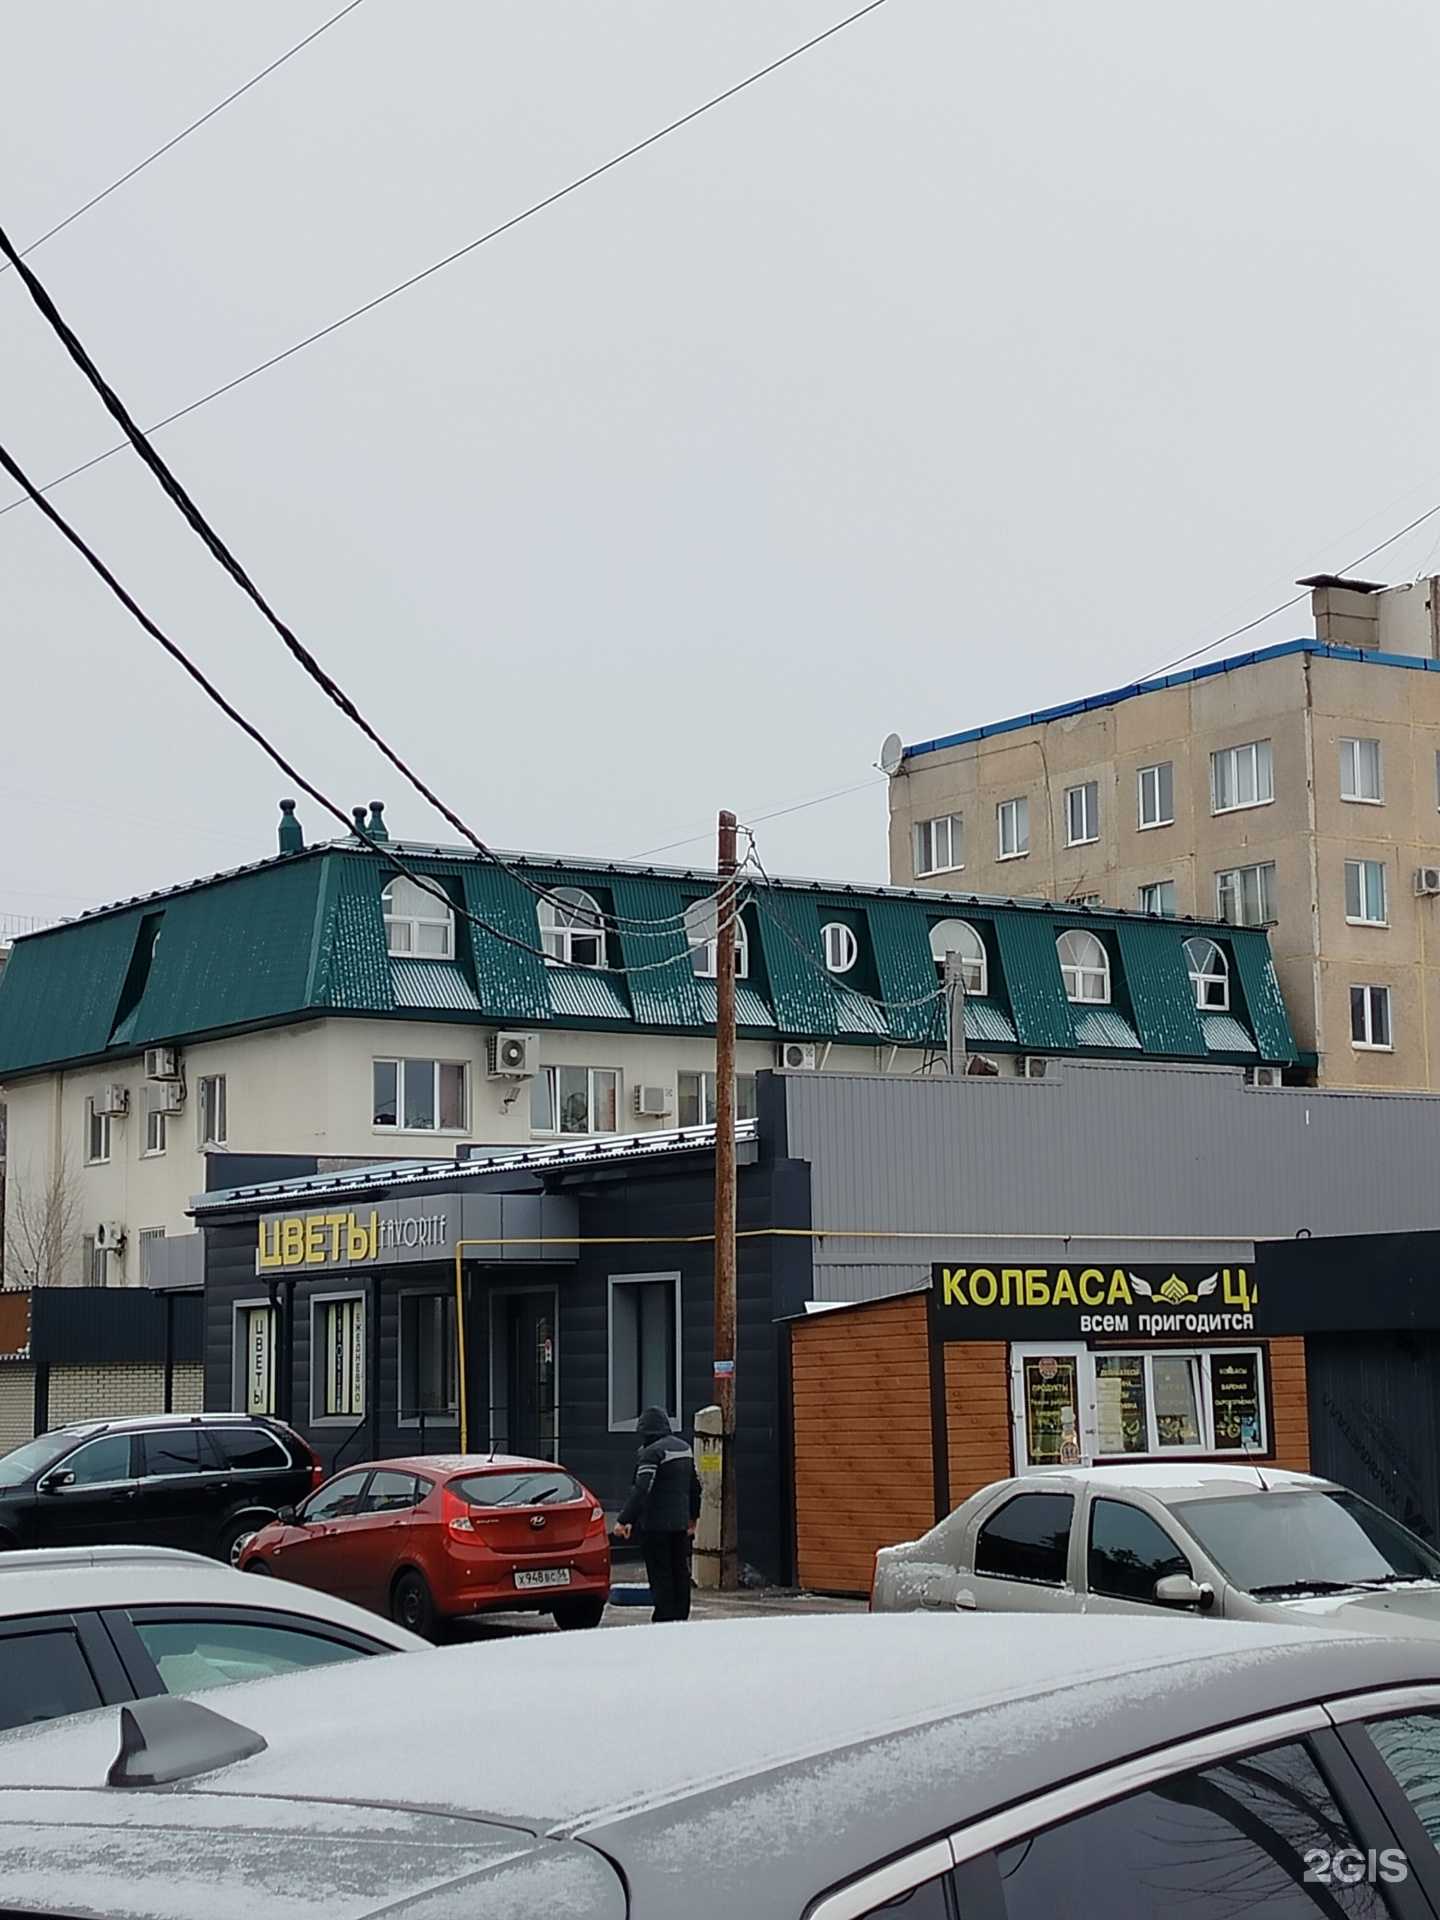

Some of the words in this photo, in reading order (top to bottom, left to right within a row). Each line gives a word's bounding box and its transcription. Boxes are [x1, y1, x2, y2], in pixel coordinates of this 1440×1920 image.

[259, 1211, 379, 1267] ЦВЕТЫ
[380, 1215, 447, 1249] FAVORITE
[942, 1268, 1133, 1306] КОЛБАСА
[1222, 1269, 1258, 1312] Ц
[1080, 1314, 1129, 1333] всем
[1139, 1313, 1254, 1336] пригодится
[253, 1319, 264, 1405] ЦВЕТЫ
[1031, 1383, 1069, 1393] ПРОДУКТЫ
